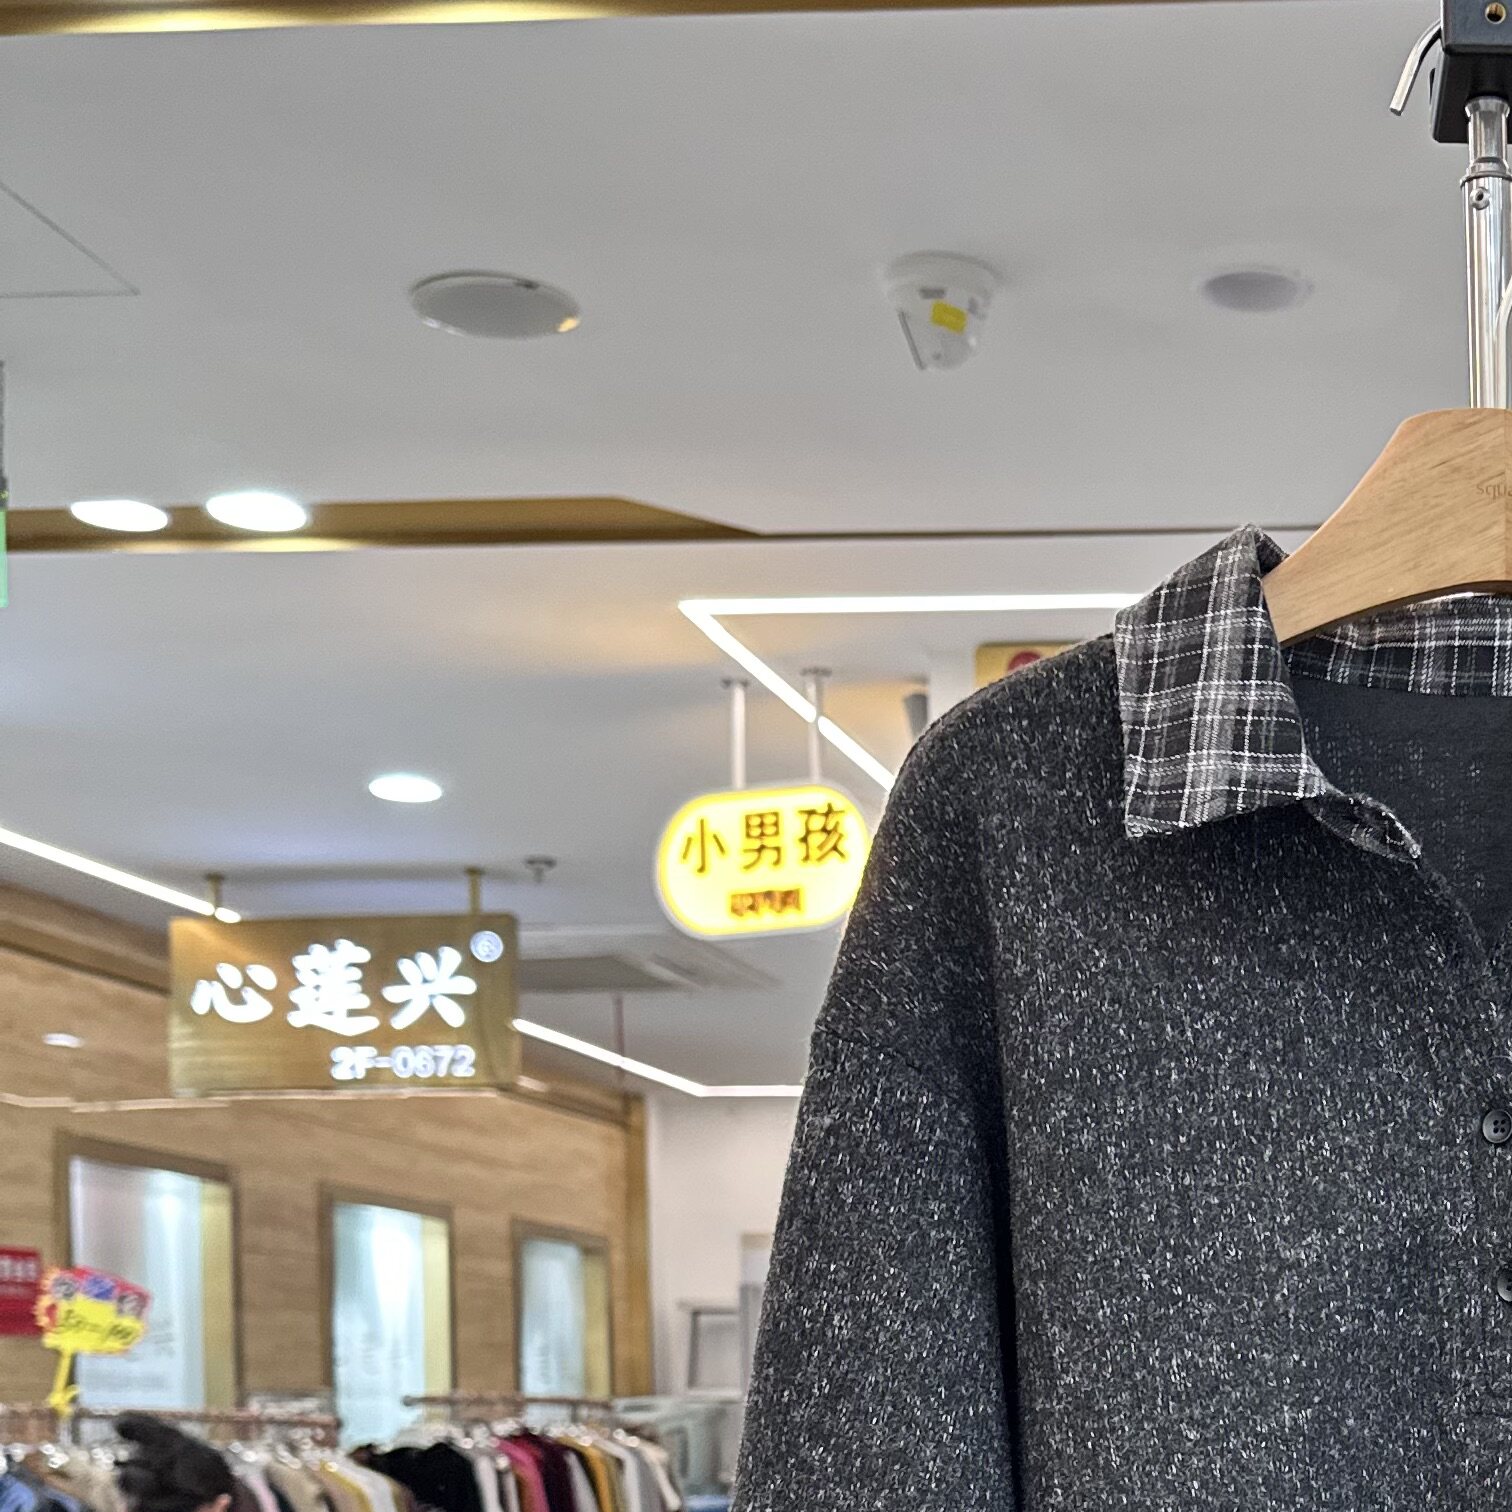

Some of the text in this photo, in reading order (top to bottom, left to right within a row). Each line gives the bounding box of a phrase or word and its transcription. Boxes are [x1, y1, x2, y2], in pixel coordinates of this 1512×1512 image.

[681, 803, 847, 874] 小男孩
[330, 1044, 477, 1081] 2F-0672
